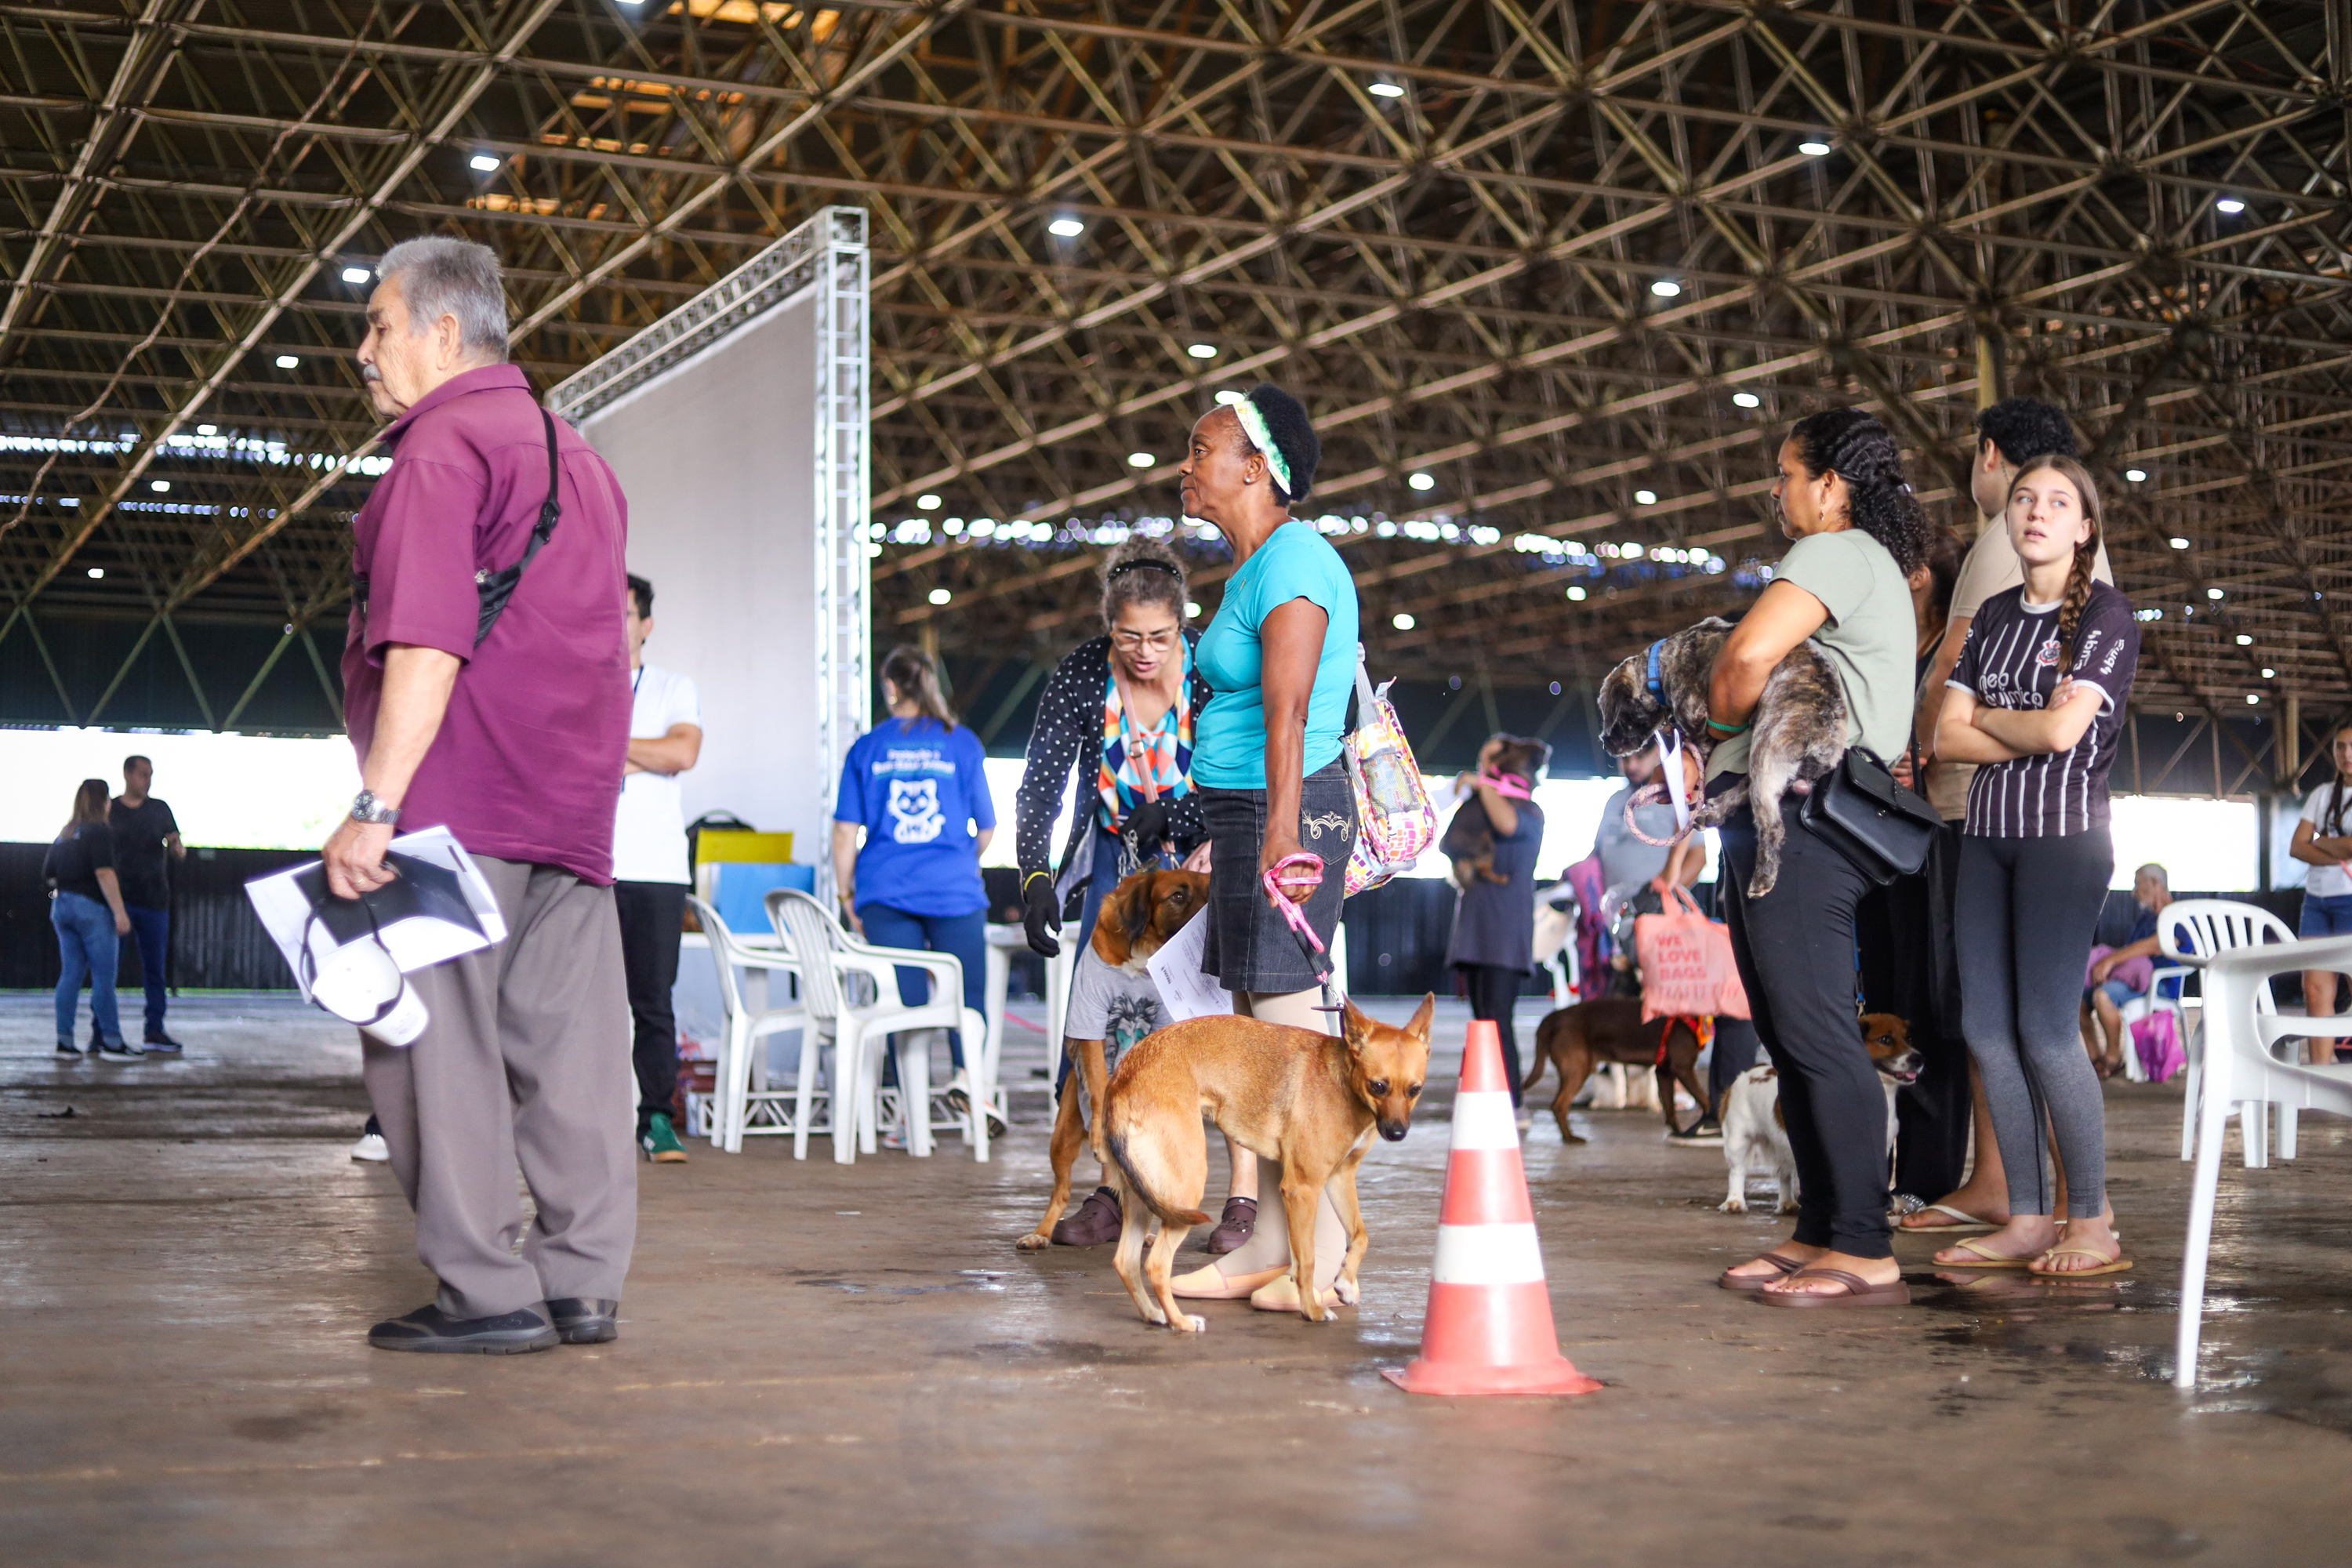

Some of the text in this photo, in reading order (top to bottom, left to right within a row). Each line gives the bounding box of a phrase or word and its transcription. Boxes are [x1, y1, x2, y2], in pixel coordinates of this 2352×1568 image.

[1979, 672, 2009, 692] neo
[1656, 935, 1681, 946] WE
[1658, 950, 1700, 963] LOVE
[1660, 967, 1707, 980] BAGS
